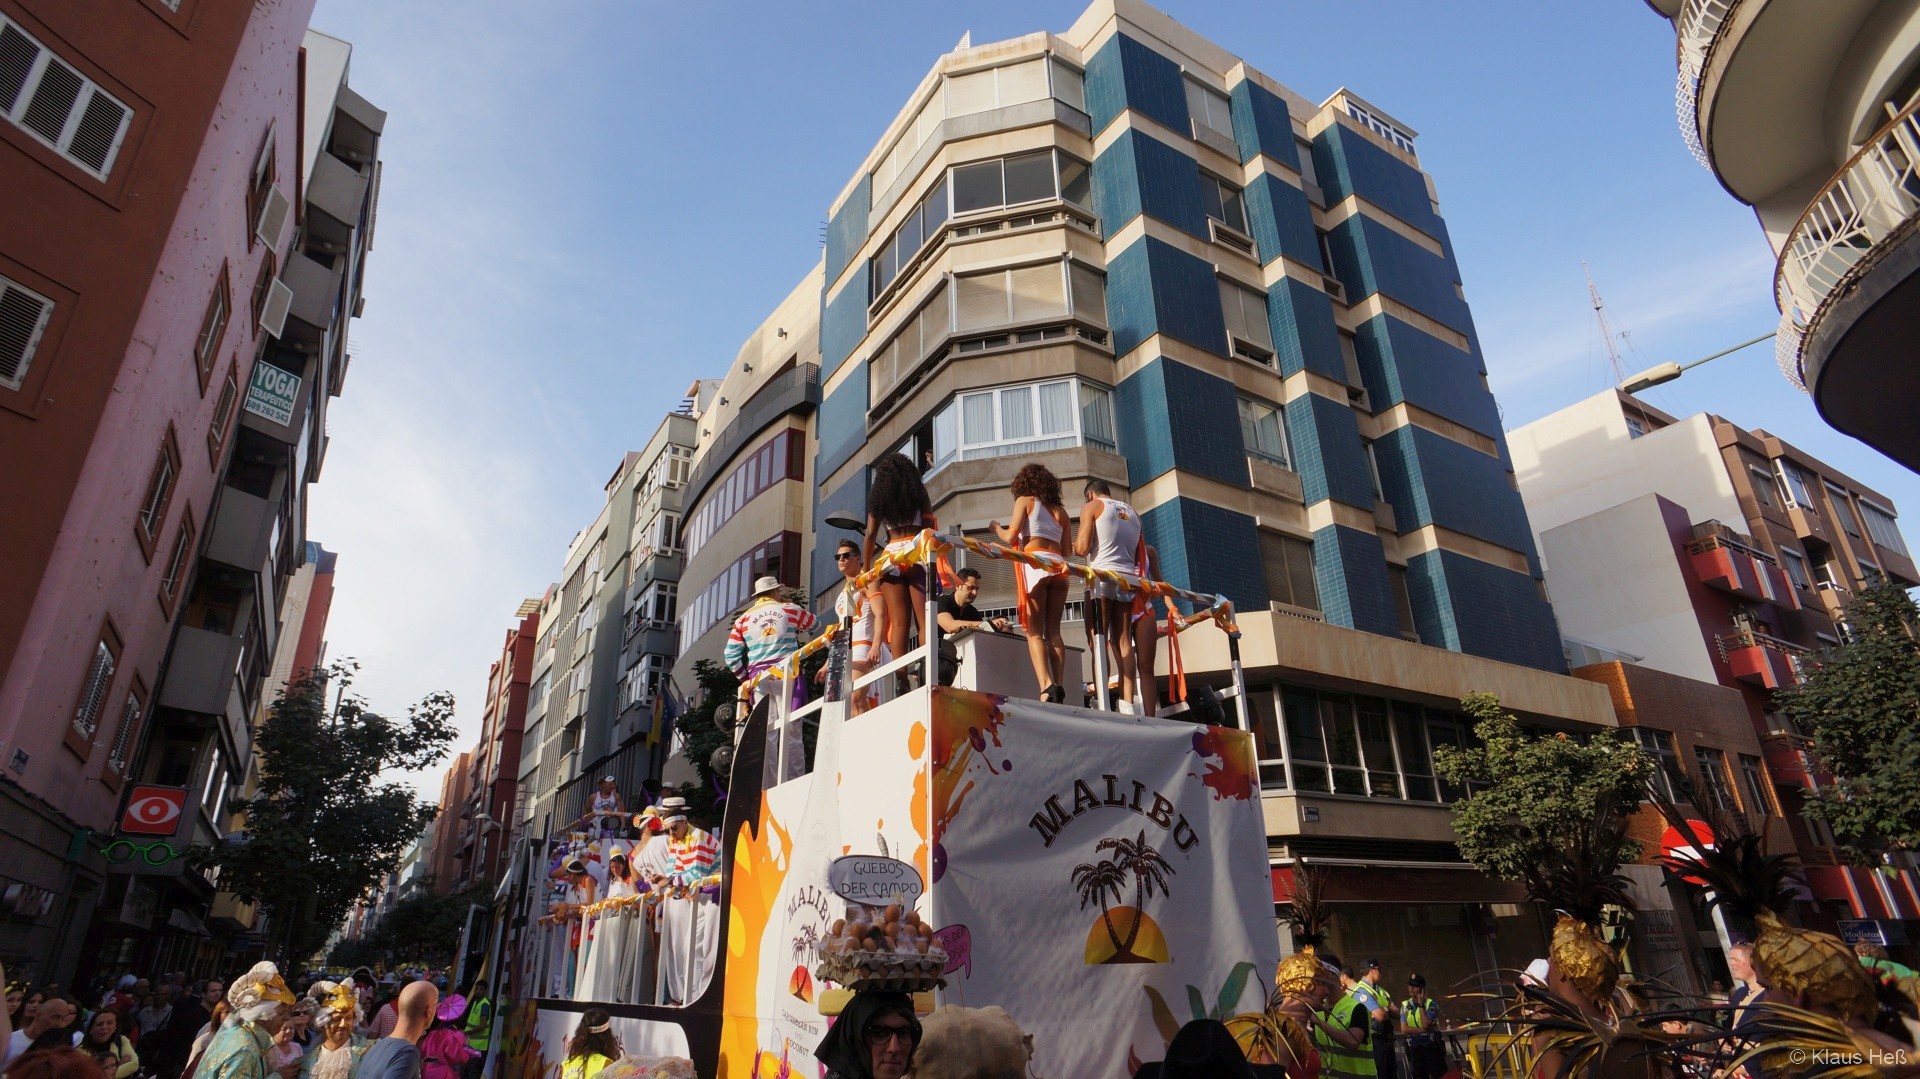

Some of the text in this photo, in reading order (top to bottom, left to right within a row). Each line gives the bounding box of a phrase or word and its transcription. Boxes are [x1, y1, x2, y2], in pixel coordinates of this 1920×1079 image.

[256, 363, 296, 400] YOGA
[250, 385, 293, 411] TERAPEUTICO
[261, 405, 275, 417] 262
[275, 411, 290, 423] 543
[752, 610, 783, 625] MALIBU
[1028, 774, 1200, 853] MALIBU
[853, 861, 904, 879] GUEBOS
[841, 881, 919, 899] DER CAMPO
[1844, 929, 1881, 938] Modistas
